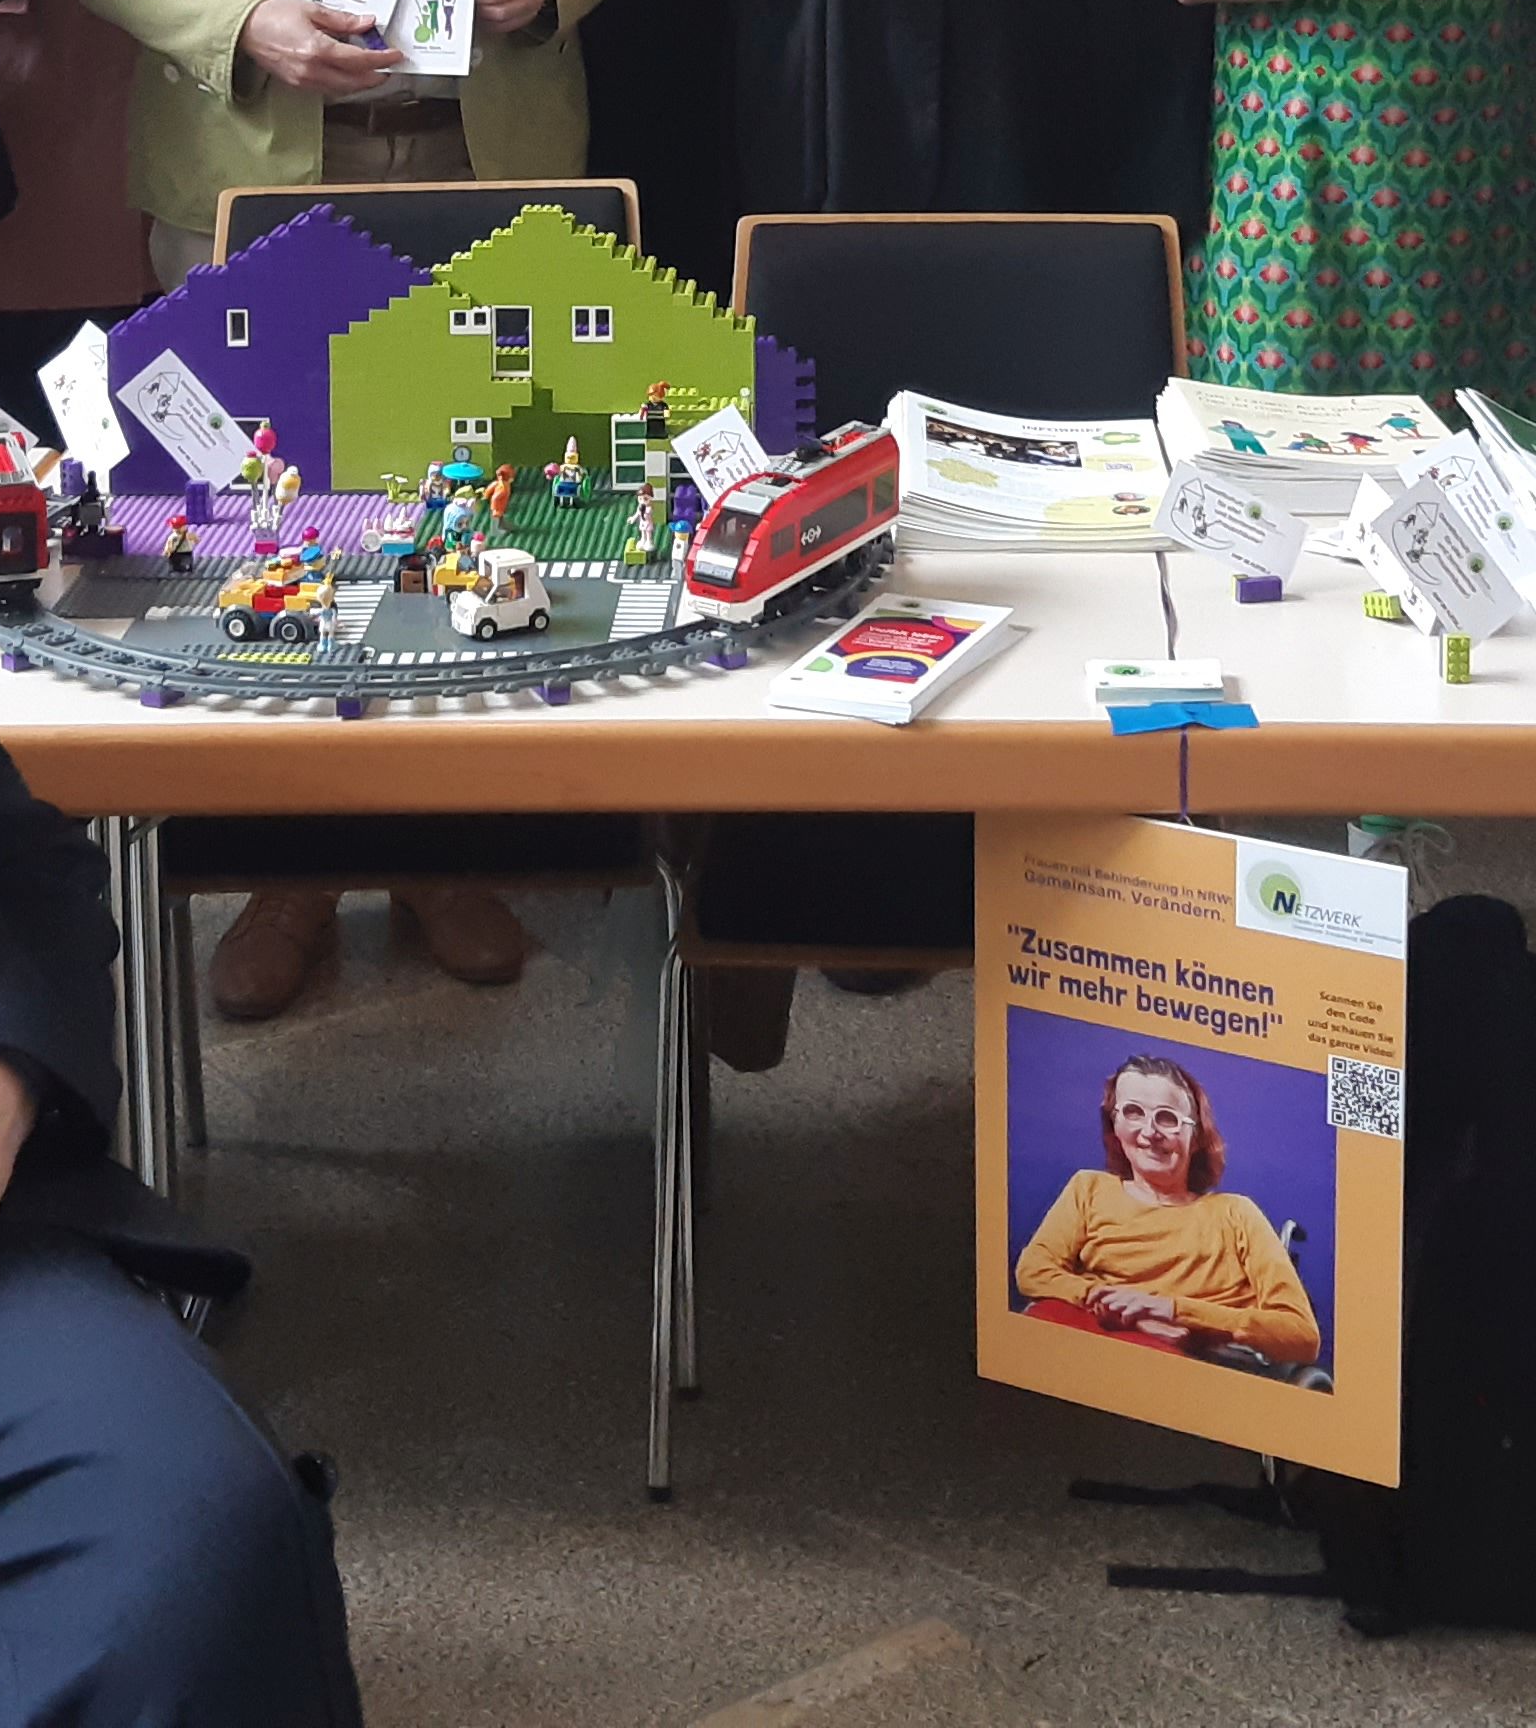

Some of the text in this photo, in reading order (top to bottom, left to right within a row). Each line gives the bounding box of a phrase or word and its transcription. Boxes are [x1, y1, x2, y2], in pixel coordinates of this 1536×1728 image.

[1024, 871, 1225, 923] Gemeinsam. Verändern.
[1094, 869, 1178, 895] Behinderung
[1182, 886, 1194, 898] in
[1272, 890, 1363, 928] NETZWERK
[1007, 924, 1274, 1006] "Zusammen können
[1007, 961, 1283, 1038] wir mehr bewegen!"
[1319, 991, 1383, 1012] Scannen Sie
[1326, 1007, 1376, 1024] den Code
[1307, 1020, 1394, 1043] und schauen Sie
[1307, 1033, 1326, 1044] das
[1329, 1039, 1361, 1051] ganze
